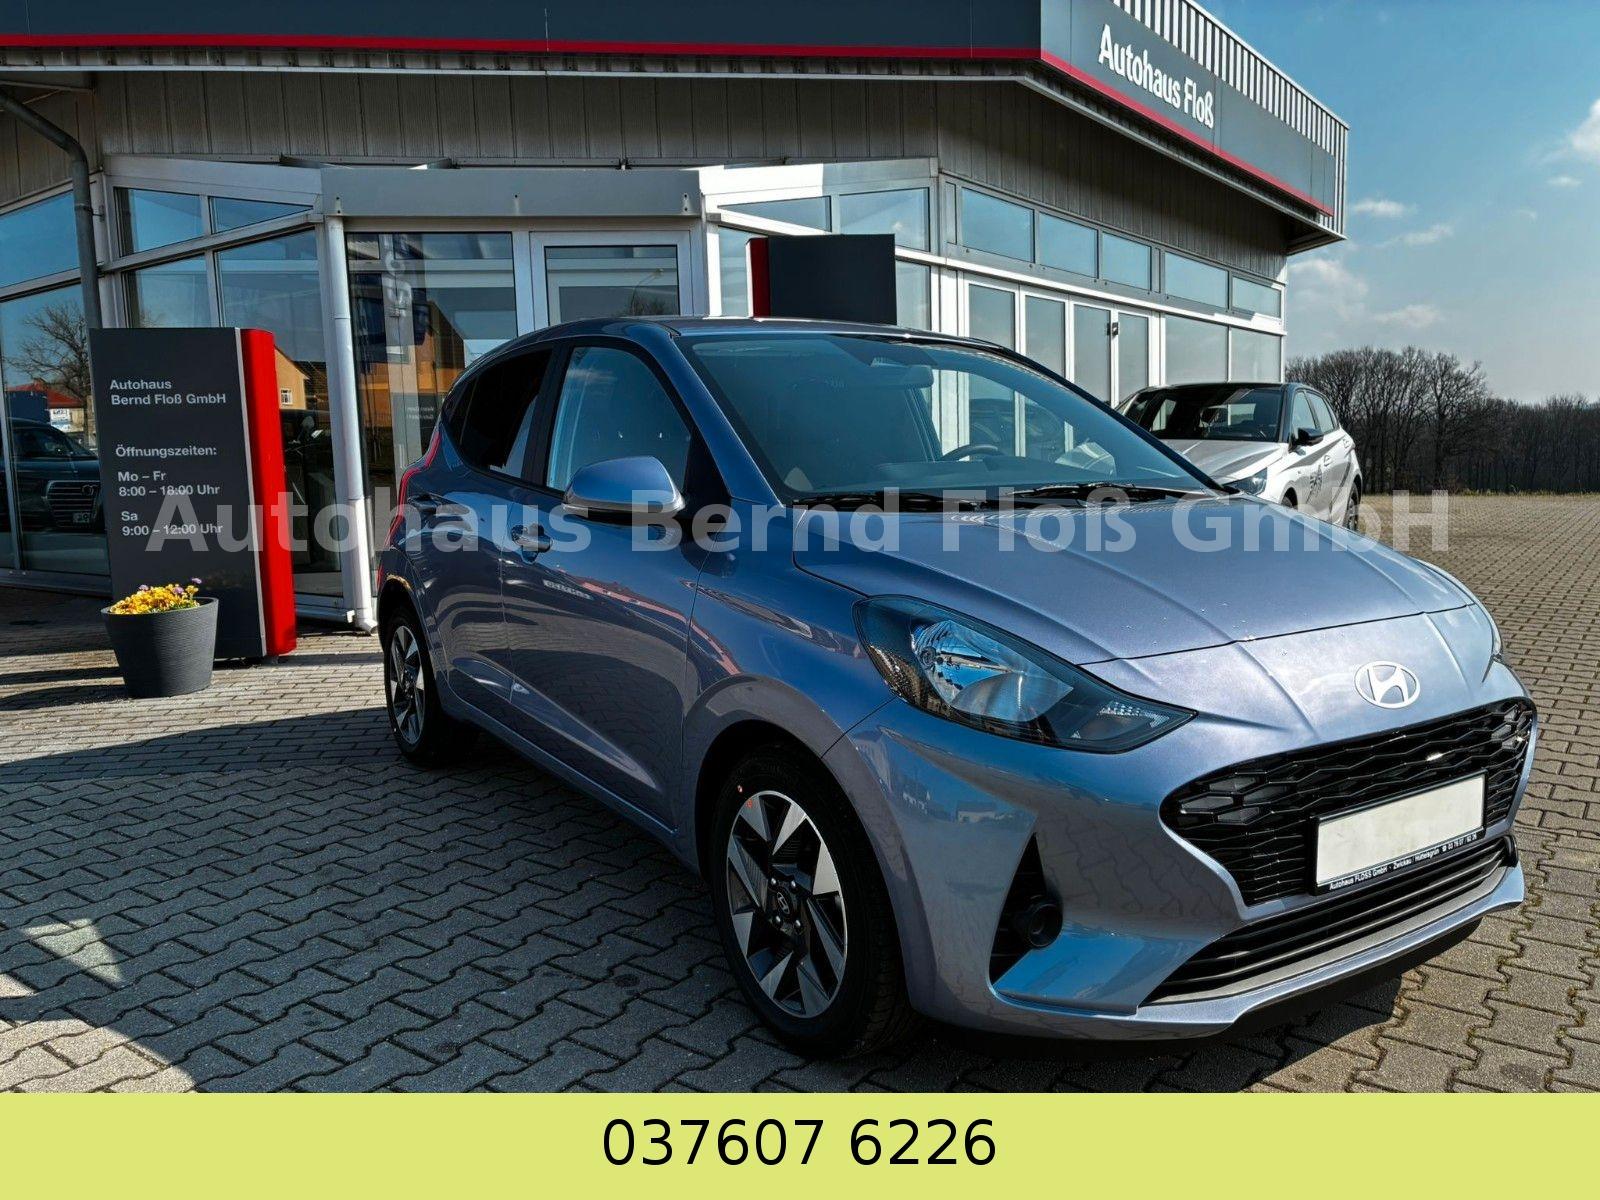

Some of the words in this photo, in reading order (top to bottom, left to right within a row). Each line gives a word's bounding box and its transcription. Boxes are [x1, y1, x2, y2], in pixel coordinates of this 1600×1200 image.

[1098, 23, 1181, 109] Autohaus
[1184, 76, 1214, 129] Floß
[110, 379, 172, 390] Autohaus
[111, 394, 151, 405] Bernd
[154, 393, 182, 405] Floß
[186, 393, 227, 404] GmbH
[115, 444, 218, 459] Öffnungszeiten:
[118, 471, 139, 482] Mo
[153, 470, 166, 481] Fr
[119, 486, 146, 497] 8:00
[160, 485, 194, 496] 18:00
[197, 484, 220, 495] Uhr
[121, 510, 138, 521] Sa
[122, 525, 149, 536] 9:00
[163, 524, 197, 535] 12:00
[200, 523, 223, 534] Uhr
